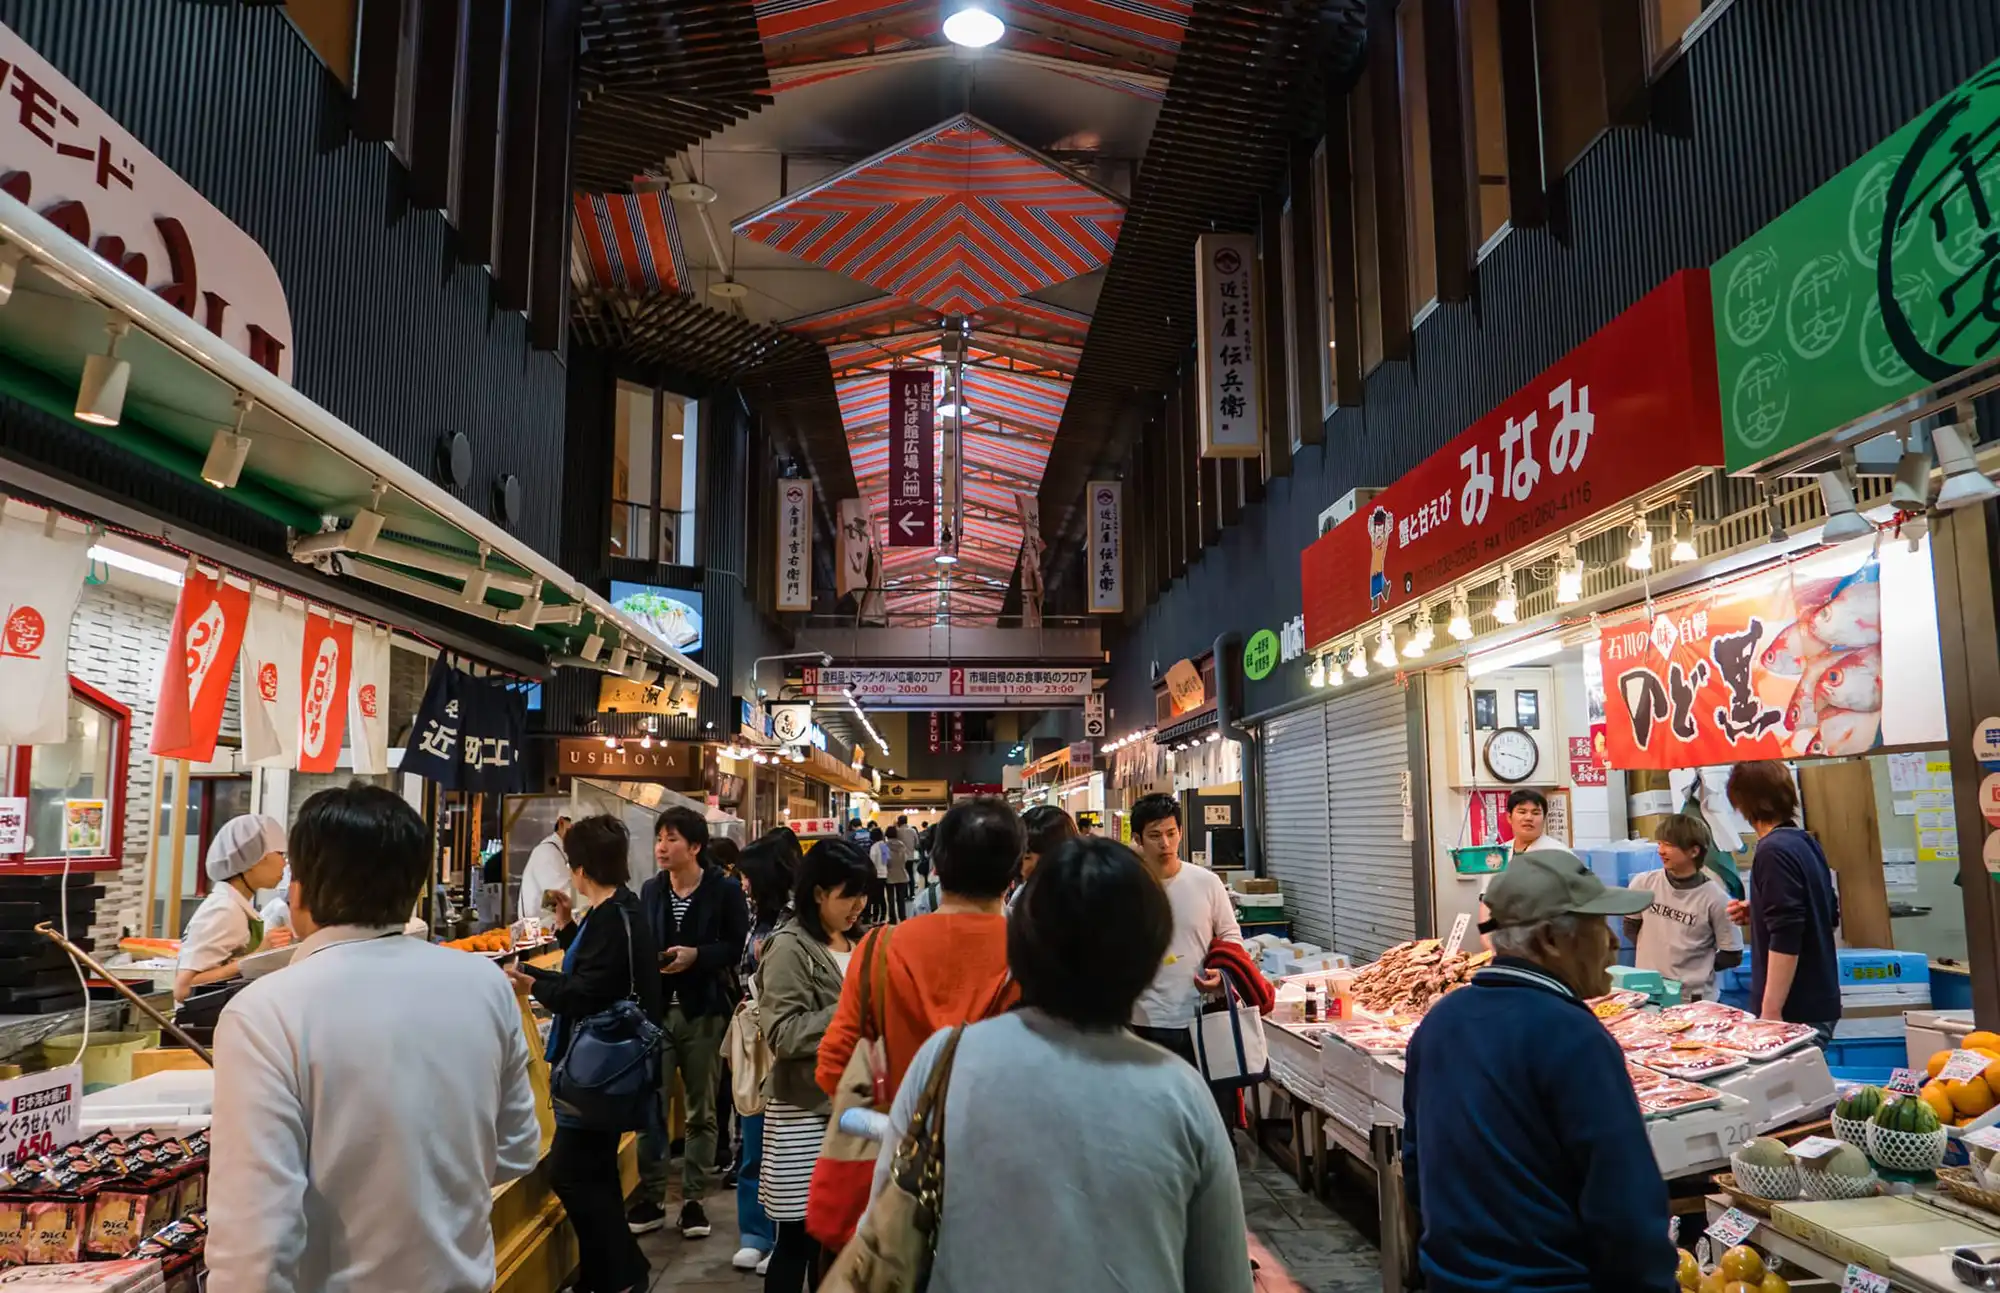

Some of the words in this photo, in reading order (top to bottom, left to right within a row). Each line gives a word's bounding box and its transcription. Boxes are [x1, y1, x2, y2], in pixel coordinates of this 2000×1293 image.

[904, 383, 920, 469] いちば館広場
[1460, 378, 1595, 527] みなみ
[804, 669, 816, 685] B1
[952, 670, 962, 685] 2
[969, 671, 1087, 684] 市場自慢のお食事処のフロア
[570, 751, 677, 767] USHIOYA
[790, 821, 835, 833] 営業中
